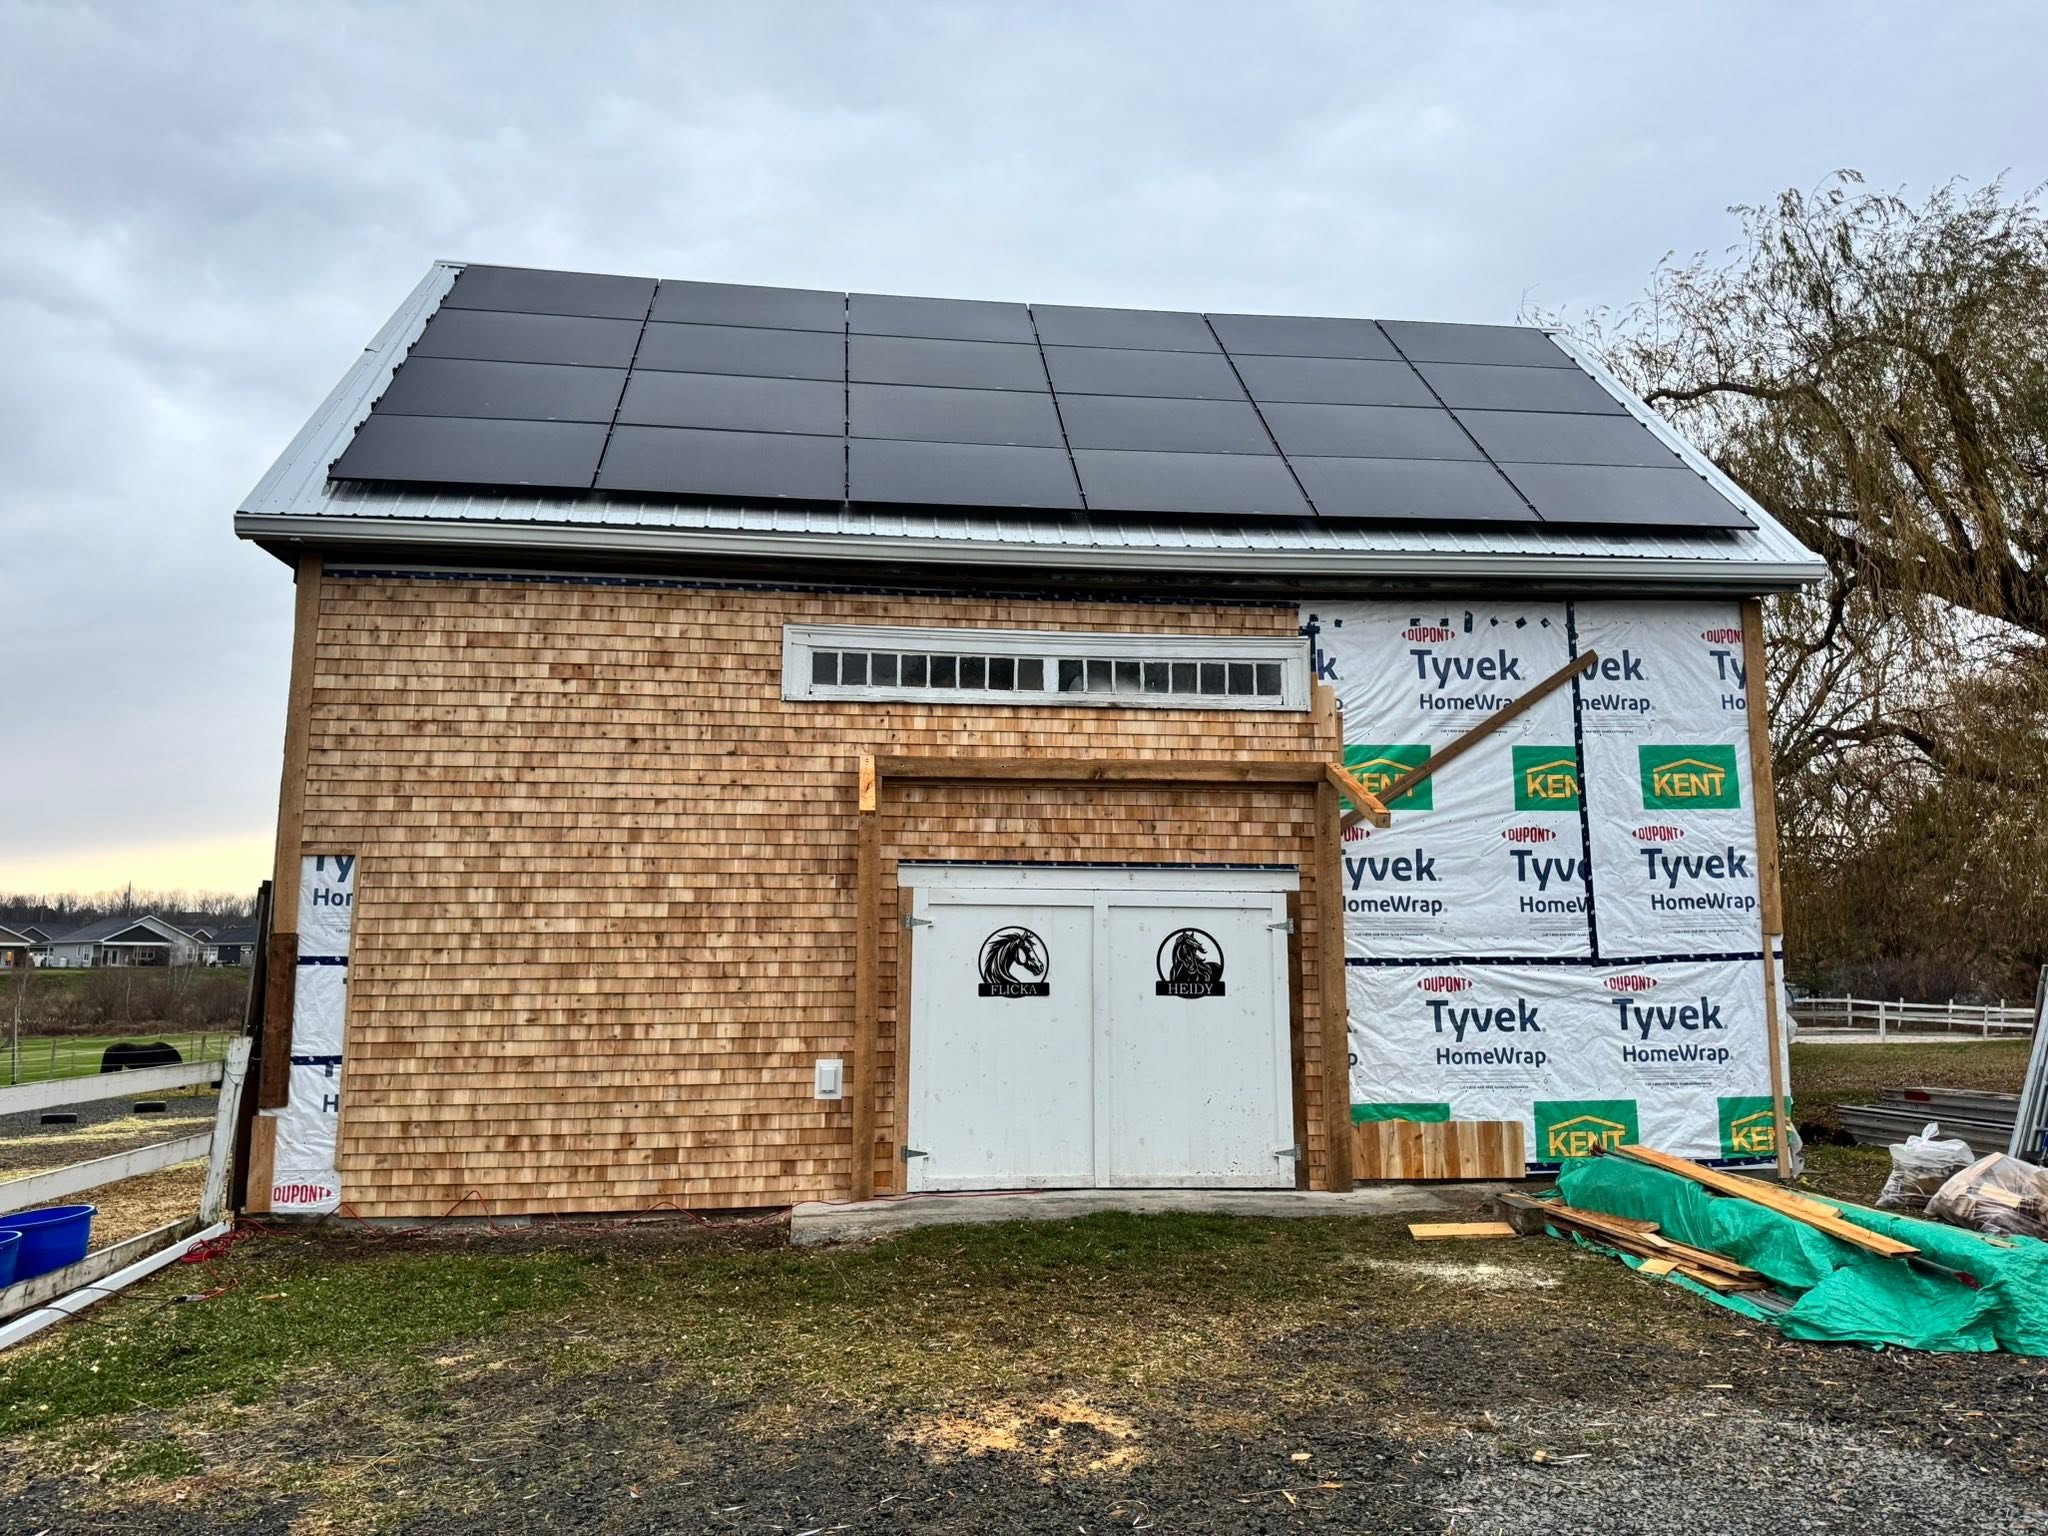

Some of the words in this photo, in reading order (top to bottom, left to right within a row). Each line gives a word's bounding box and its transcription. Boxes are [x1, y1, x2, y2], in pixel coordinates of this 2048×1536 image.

[1408, 627, 1450, 642] DUPONT
[1409, 649, 1522, 689] Tyvek
[1653, 772, 1726, 797] KENT
[1508, 826, 1551, 843] DUPONT
[1638, 825, 1679, 842] DUPONT
[1640, 846, 1749, 889] Tyvek
[1651, 892, 1756, 912] HomeWrap
[990, 984, 1038, 995] FLICKA
[1167, 983, 1215, 995] HEIDY
[1424, 976, 1467, 992] DUPONT
[1609, 975, 1651, 991] DUPONT
[1425, 998, 1541, 1043] Tyvek
[1612, 996, 1723, 1040] Tyvek
[1436, 1047, 1547, 1068] HomeWrap
[1623, 1045, 1730, 1064] HomeWrap
[1549, 1130, 1626, 1157] KENT
[273, 1184, 325, 1204] DUPONT
